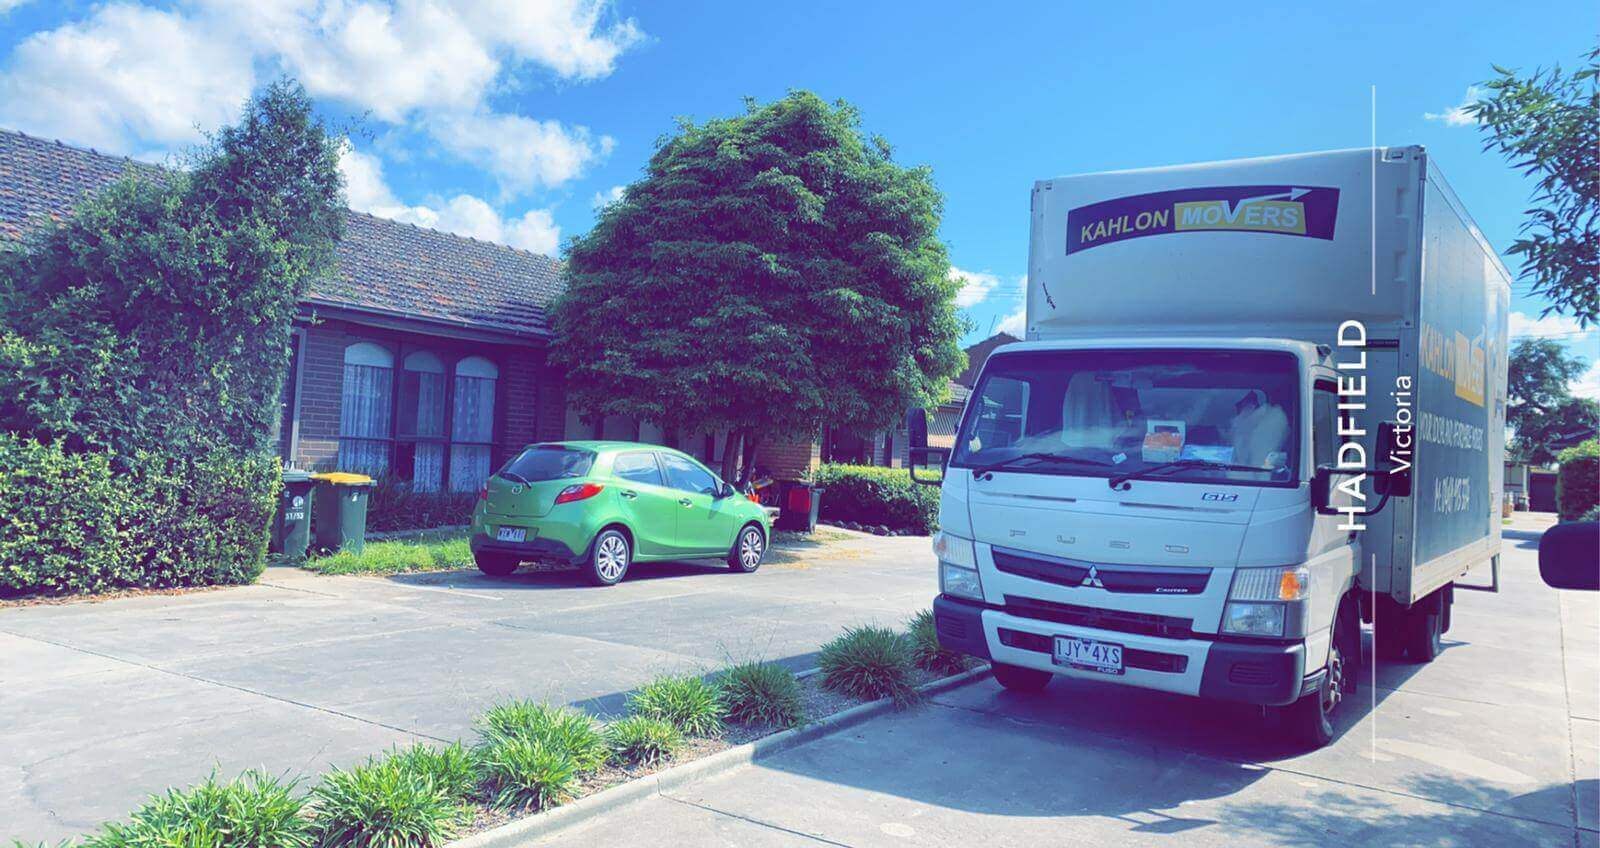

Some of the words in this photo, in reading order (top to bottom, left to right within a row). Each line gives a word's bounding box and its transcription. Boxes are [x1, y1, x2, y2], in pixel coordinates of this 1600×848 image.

[1080, 209, 1169, 243] KAHLON
[1181, 200, 1299, 228] MOVERS
[1056, 639, 1081, 658] 1JY
[1092, 645, 1120, 664] 4XS
